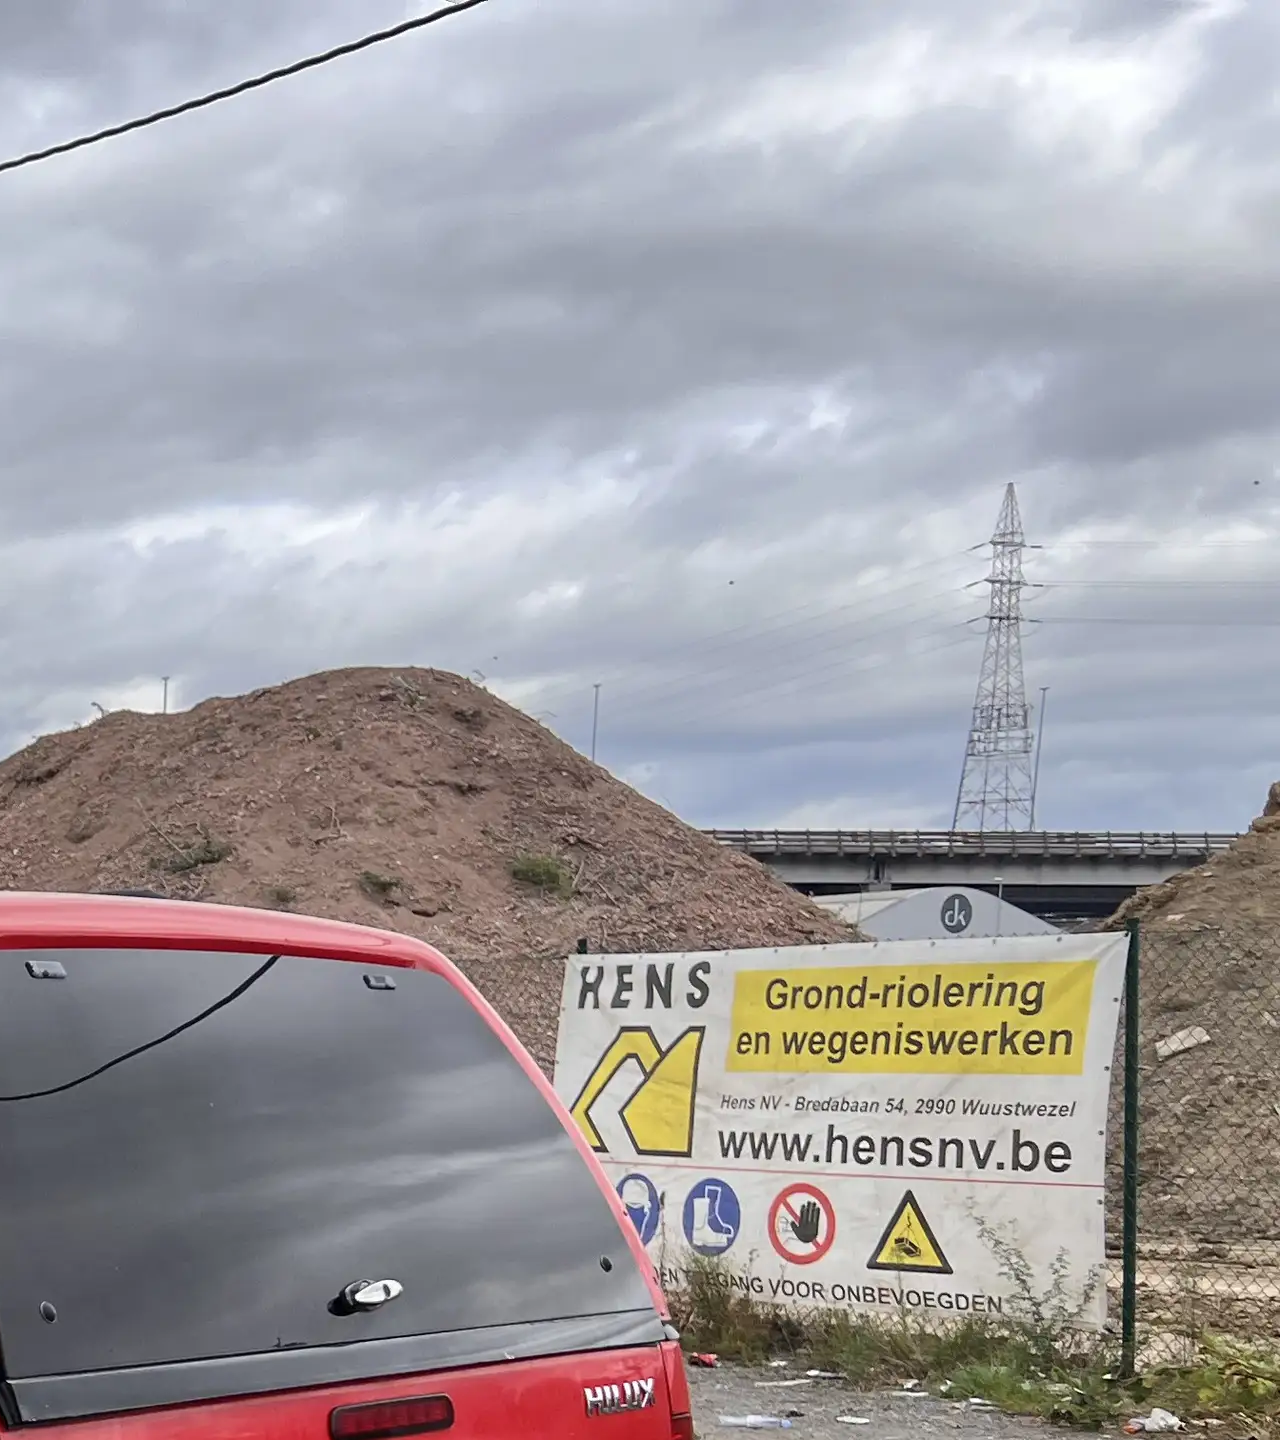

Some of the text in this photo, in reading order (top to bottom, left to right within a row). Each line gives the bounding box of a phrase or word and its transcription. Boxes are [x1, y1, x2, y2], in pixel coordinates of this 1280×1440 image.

[944, 898, 966, 926] dk
[578, 961, 711, 1009] HENS
[765, 973, 1045, 1016] Grond-riolering
[736, 1021, 1074, 1064] en wegeniswerken
[720, 1094, 755, 1111] Hens
[760, 1096, 781, 1111] NV
[794, 1096, 879, 1113] Bredabaan
[885, 1098, 908, 1117] 54,
[914, 1099, 956, 1116] 2990
[961, 1099, 1077, 1118] Wuustwezel
[718, 1124, 1072, 1173] www.hensnv.be
[769, 1278, 827, 1301] VOOR
[831, 1284, 1003, 1313] ONBEVOEGDEN
[584, 1377, 656, 1417] HILUX
